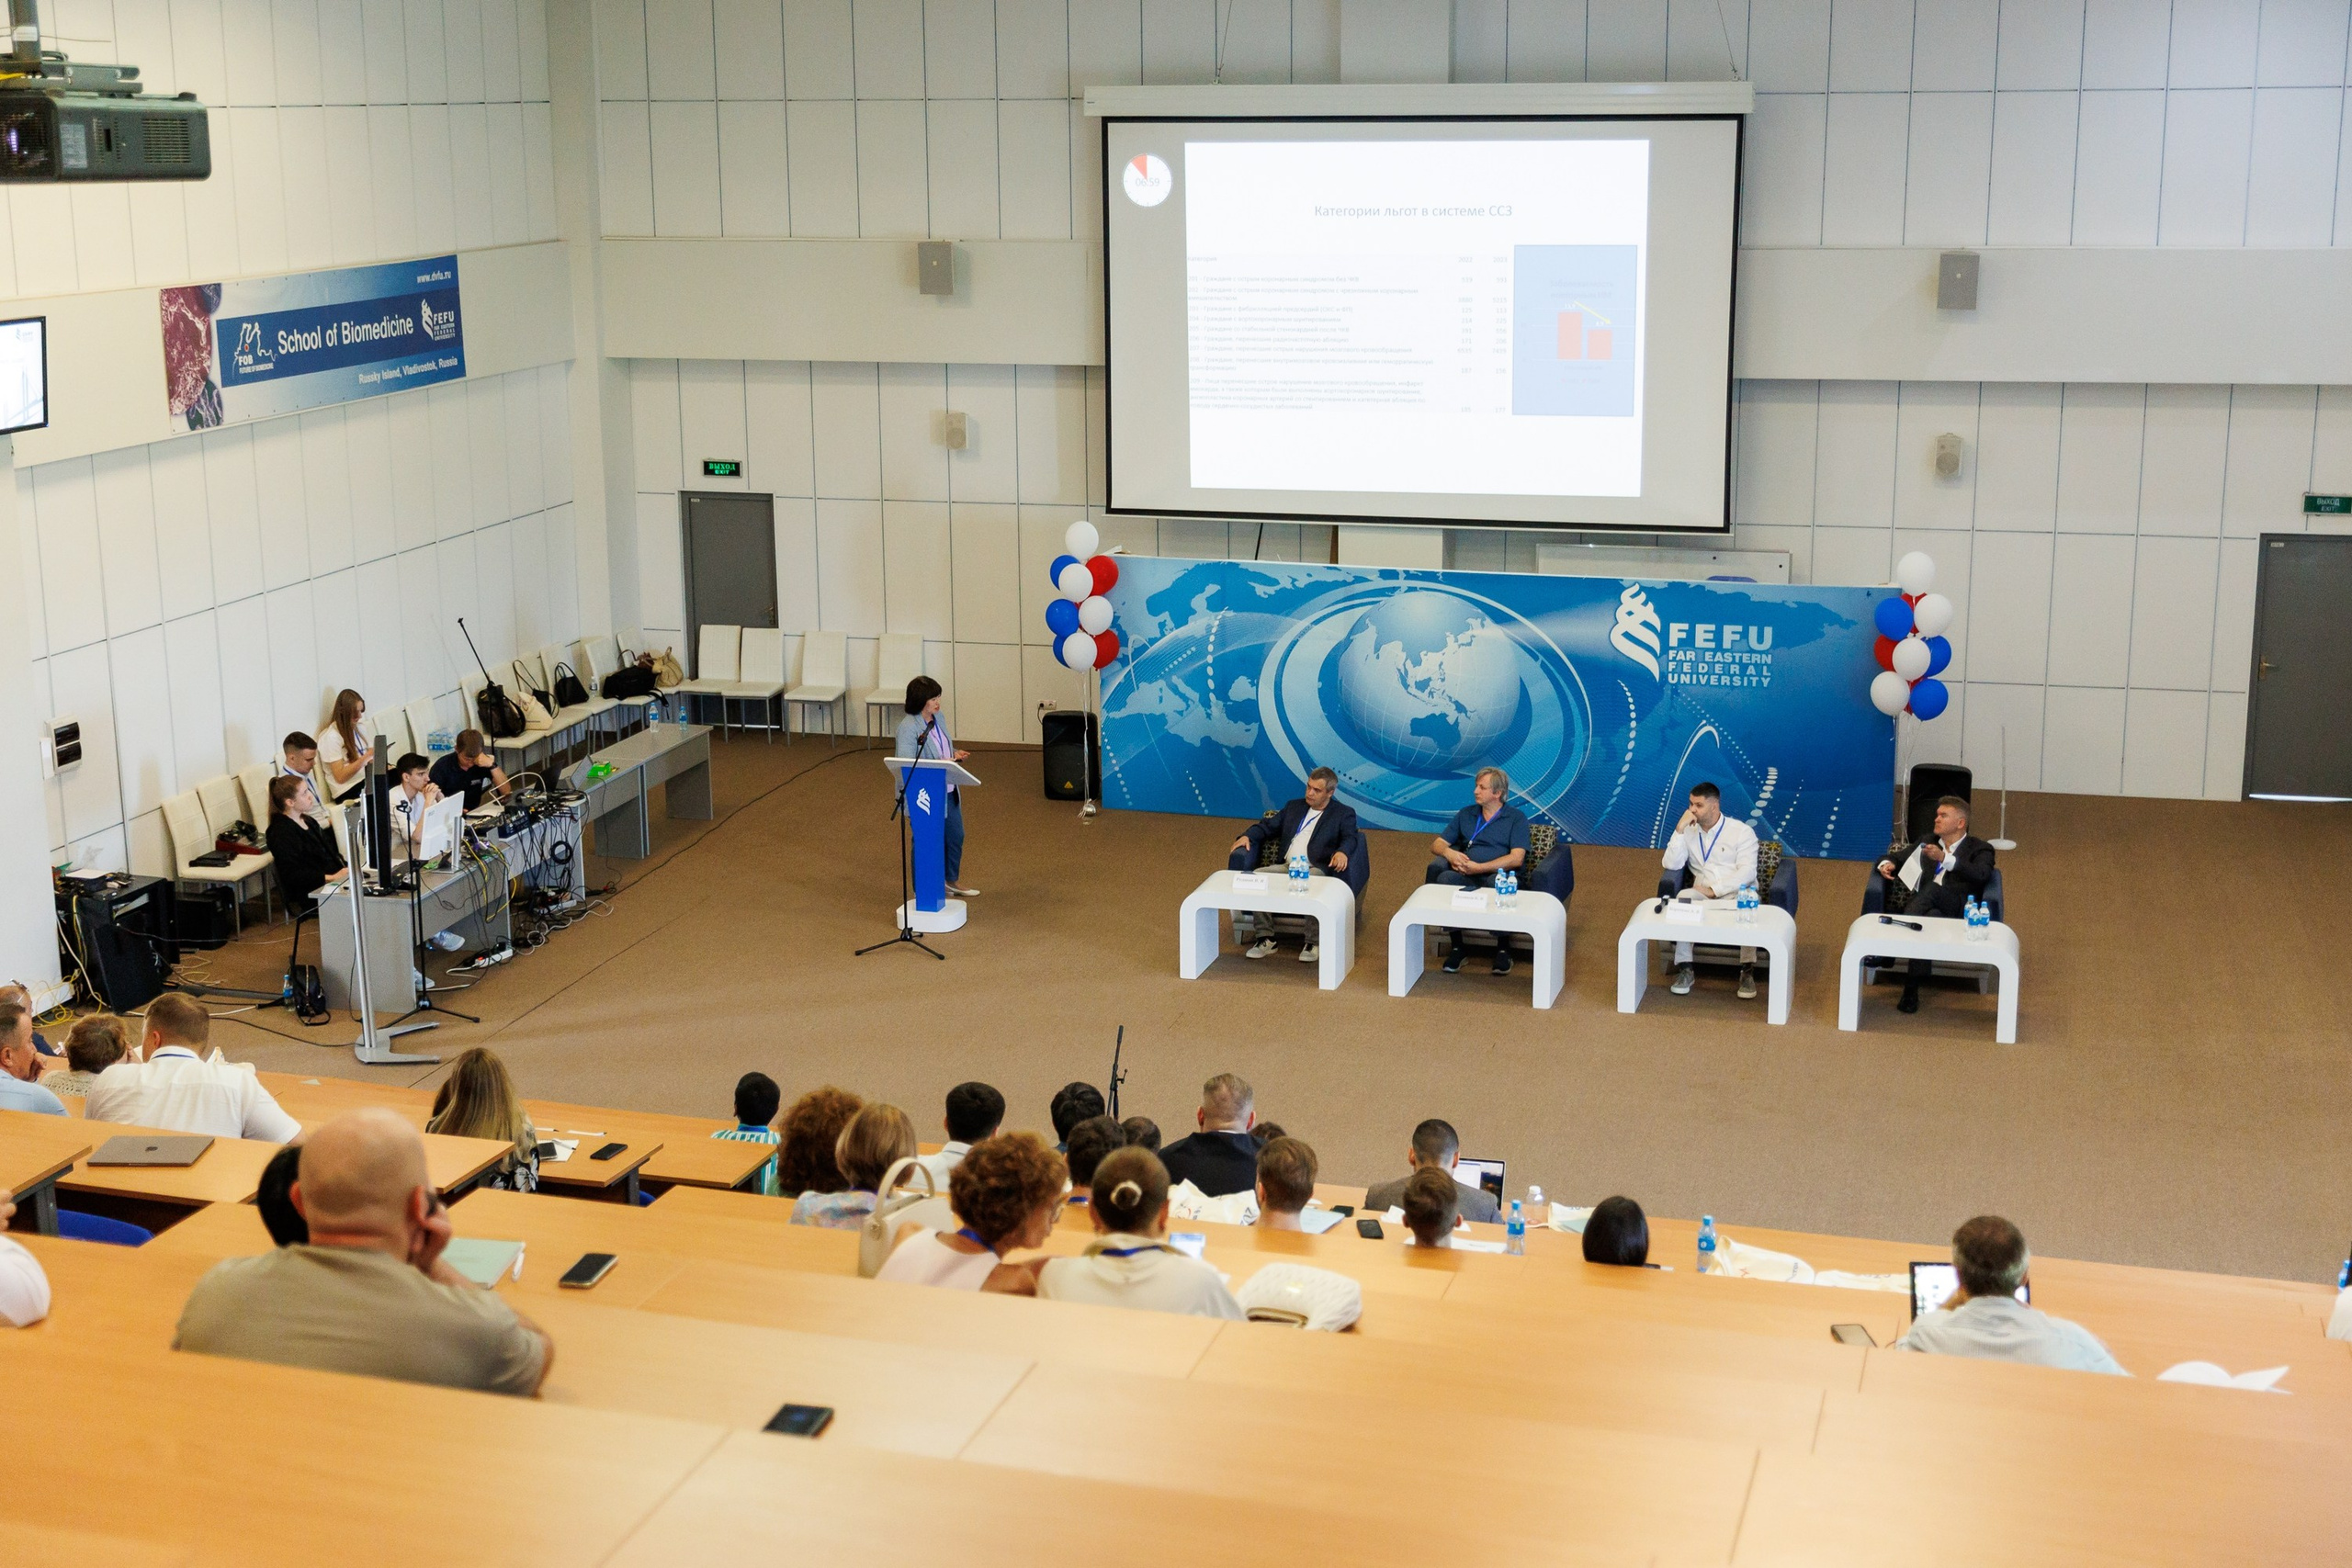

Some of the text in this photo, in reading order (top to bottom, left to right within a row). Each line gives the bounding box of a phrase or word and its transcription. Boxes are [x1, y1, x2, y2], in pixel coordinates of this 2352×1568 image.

[1315, 205, 1380, 220] Категории
[1384, 207, 1419, 217] льгот
[1421, 207, 1429, 217] в
[1432, 207, 1485, 217] системе
[416, 270, 451, 284] www.dvfu.ru
[433, 310, 455, 324] FEFU
[277, 314, 413, 355] School of Biomedicine
[238, 354, 254, 366] FOB
[358, 355, 458, 384] Russky Island, Vladivostok, Russia
[2316, 497, 2340, 506] ВЫХОД
[1668, 622, 1773, 651] FEFU
[1668, 649, 1771, 665] FAR EASTERN
[1668, 661, 1771, 676] FEDERAL
[1668, 673, 1771, 687] UNIVERSITY
